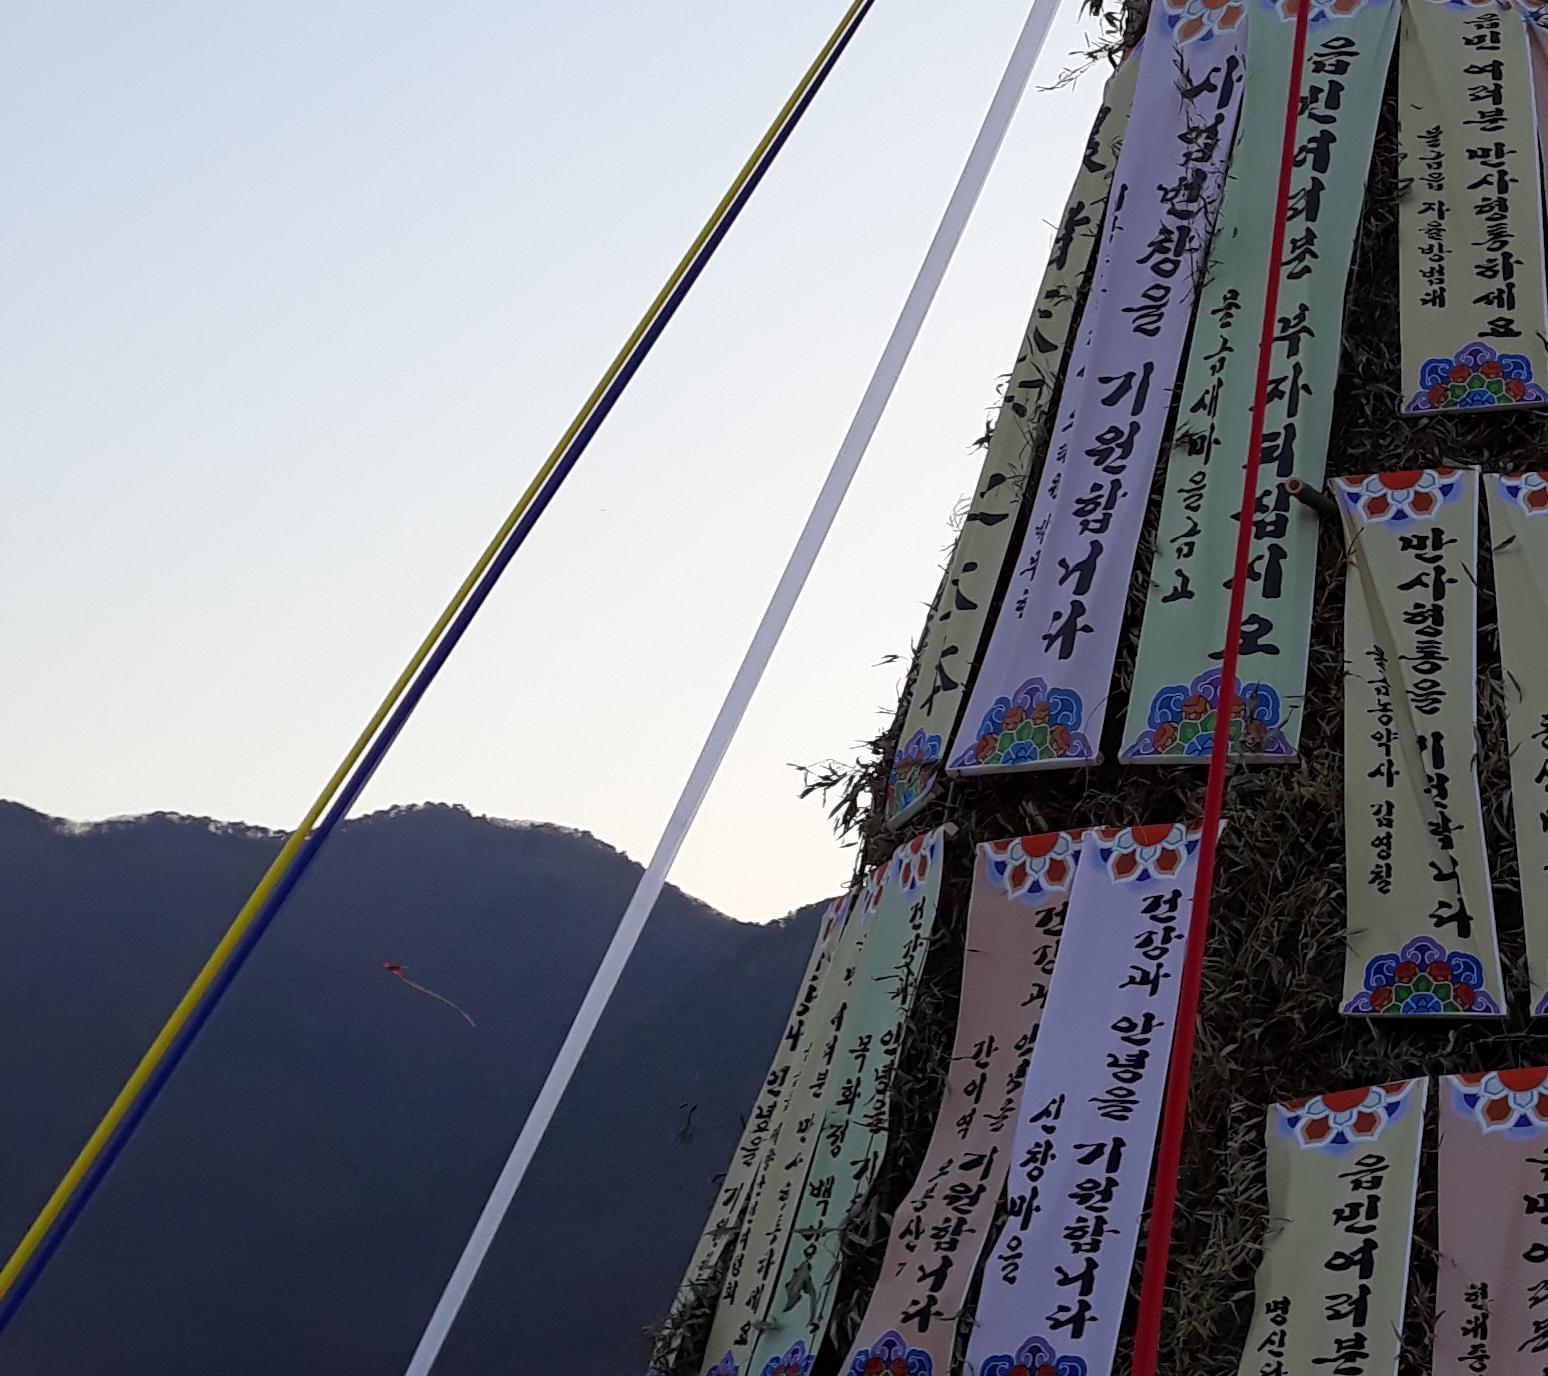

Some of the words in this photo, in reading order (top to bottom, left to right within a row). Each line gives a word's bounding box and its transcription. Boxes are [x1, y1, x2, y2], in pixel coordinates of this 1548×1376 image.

[1121, 54, 1243, 338] 사업번창을
[1464, 141, 1522, 339] 만사형통하세요
[1042, 361, 1154, 660] 기원합니다
[1162, 288, 1242, 603] 물금새마을금고
[1397, 527, 1458, 716] 만사형통을
[1416, 730, 1473, 939] 기원합니다
[1119, 888, 1184, 997] 건강과
[1089, 1012, 1165, 1122] 안녕을
[900, 1146, 999, 1333] 기원합니다
[998, 1093, 1066, 1285] 신창마을
[1045, 1137, 1128, 1339] 기원합니다
